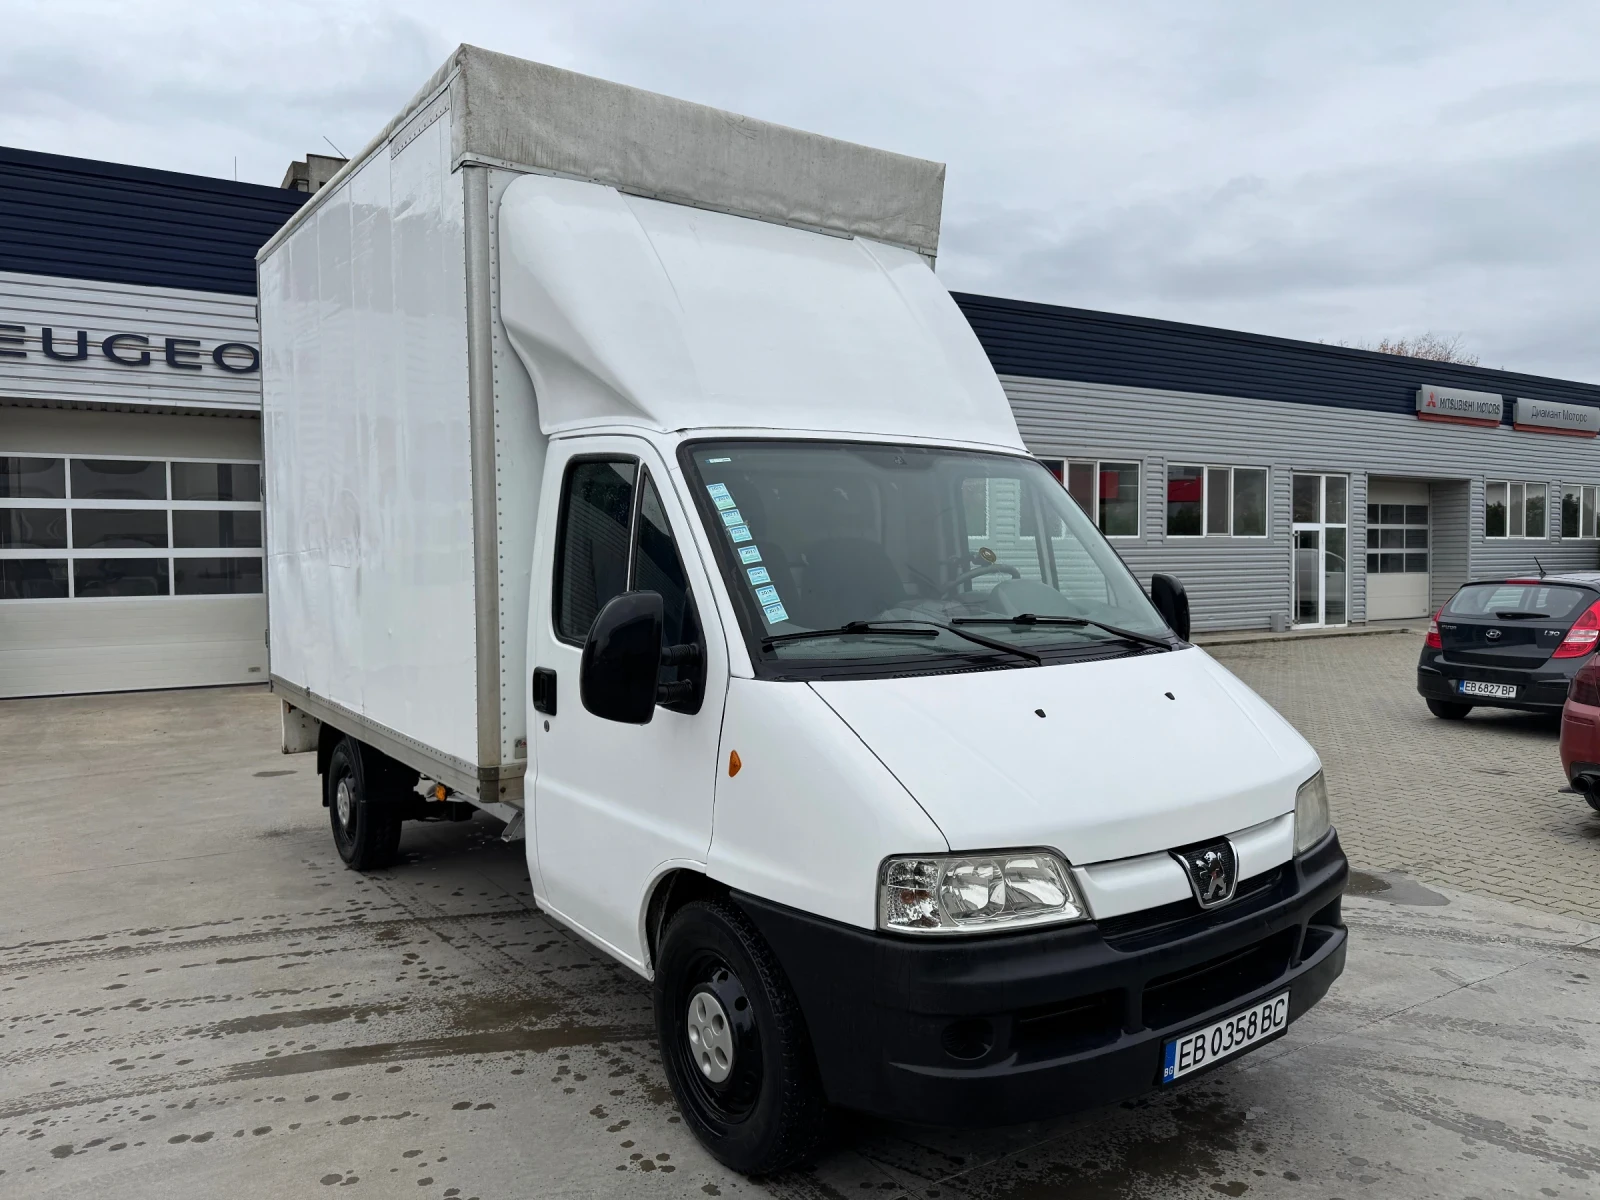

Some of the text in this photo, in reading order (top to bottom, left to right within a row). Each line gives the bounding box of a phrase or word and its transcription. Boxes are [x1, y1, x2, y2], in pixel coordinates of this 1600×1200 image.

[1439, 397, 1500, 415] MITSUBISHI MOTORS
[1531, 405, 1588, 424] Диамант Моторс
[1465, 681, 1477, 692] EB
[1478, 683, 1501, 694] 6827
[1502, 685, 1515, 696] BP
[1178, 998, 1285, 1072] EB 0358 BC
[1163, 1065, 1174, 1078] BG
